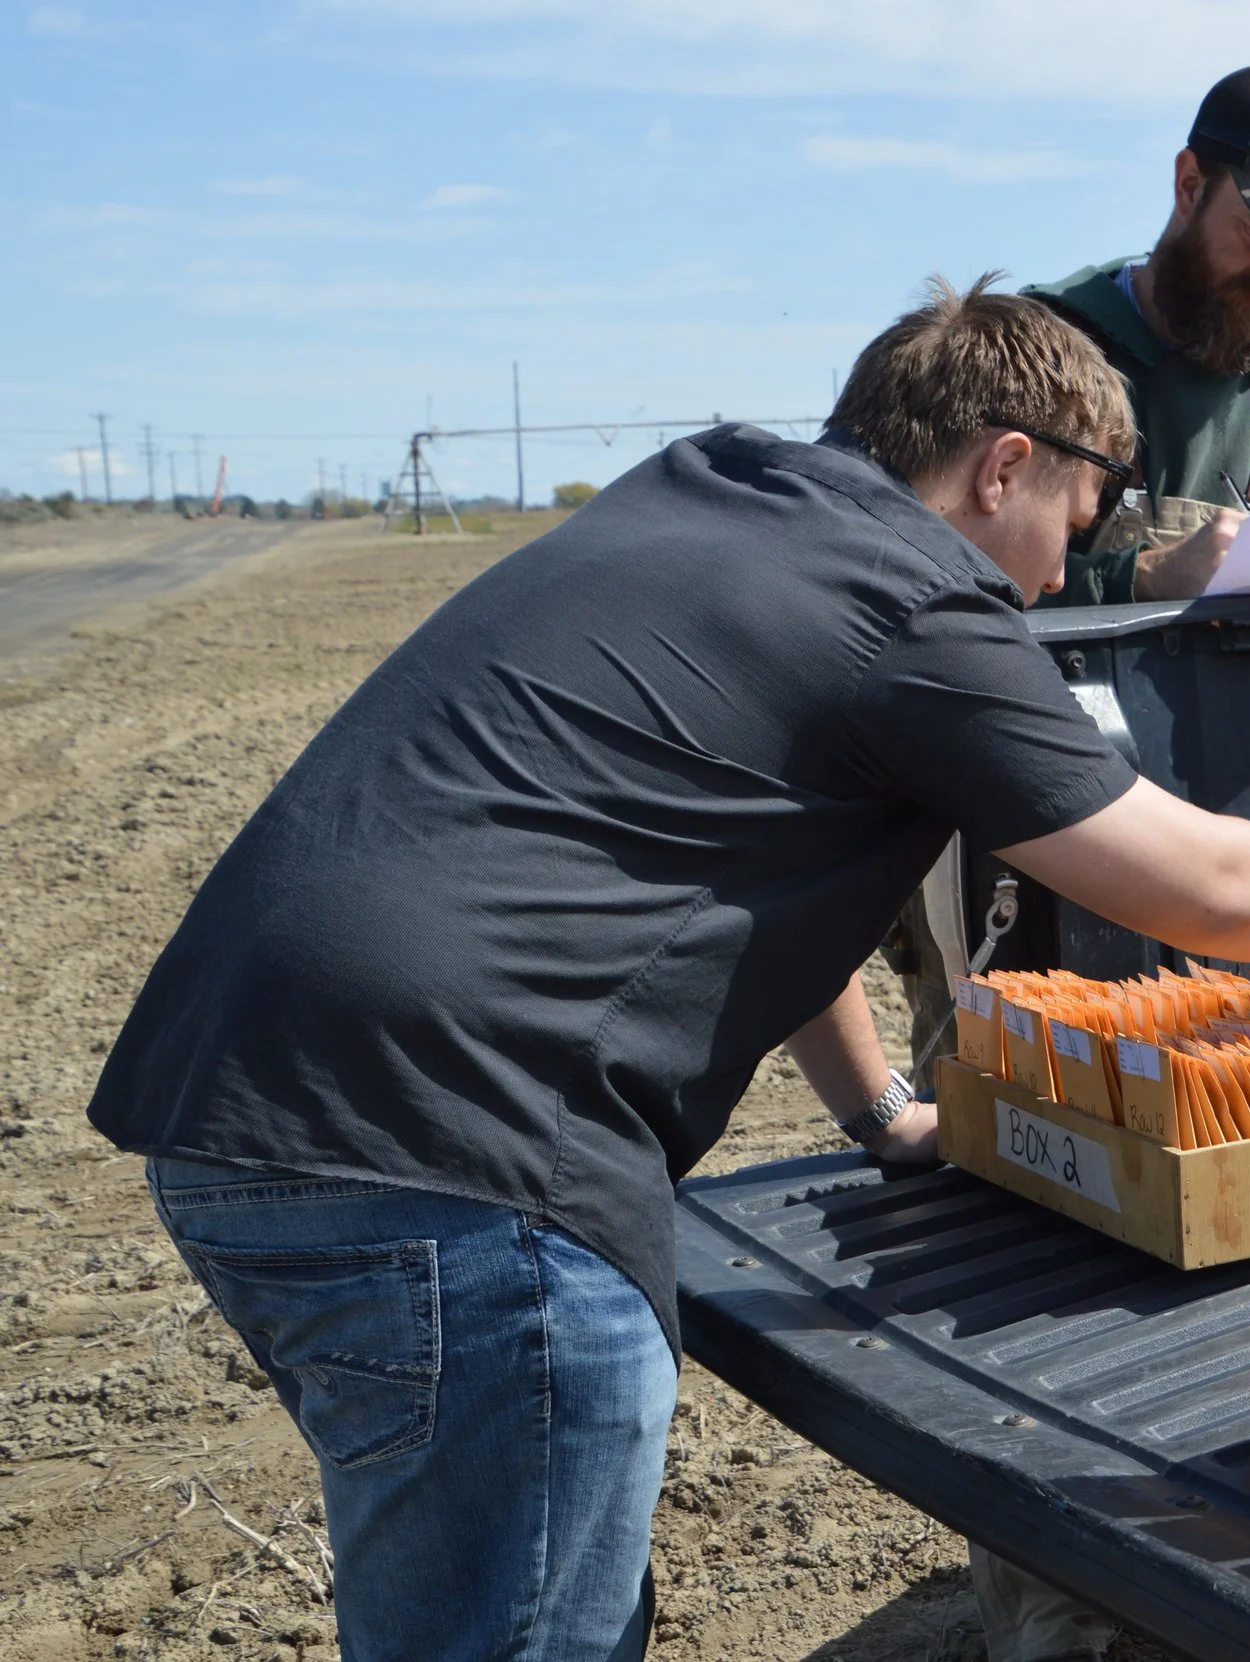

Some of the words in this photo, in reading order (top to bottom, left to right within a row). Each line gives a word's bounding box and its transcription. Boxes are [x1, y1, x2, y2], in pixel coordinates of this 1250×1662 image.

[1009, 1108, 1057, 1173] BOX
[1063, 1136, 1081, 1187] 2
[1130, 1104, 1153, 1134] Row
[1155, 1111, 1166, 1137] 12
